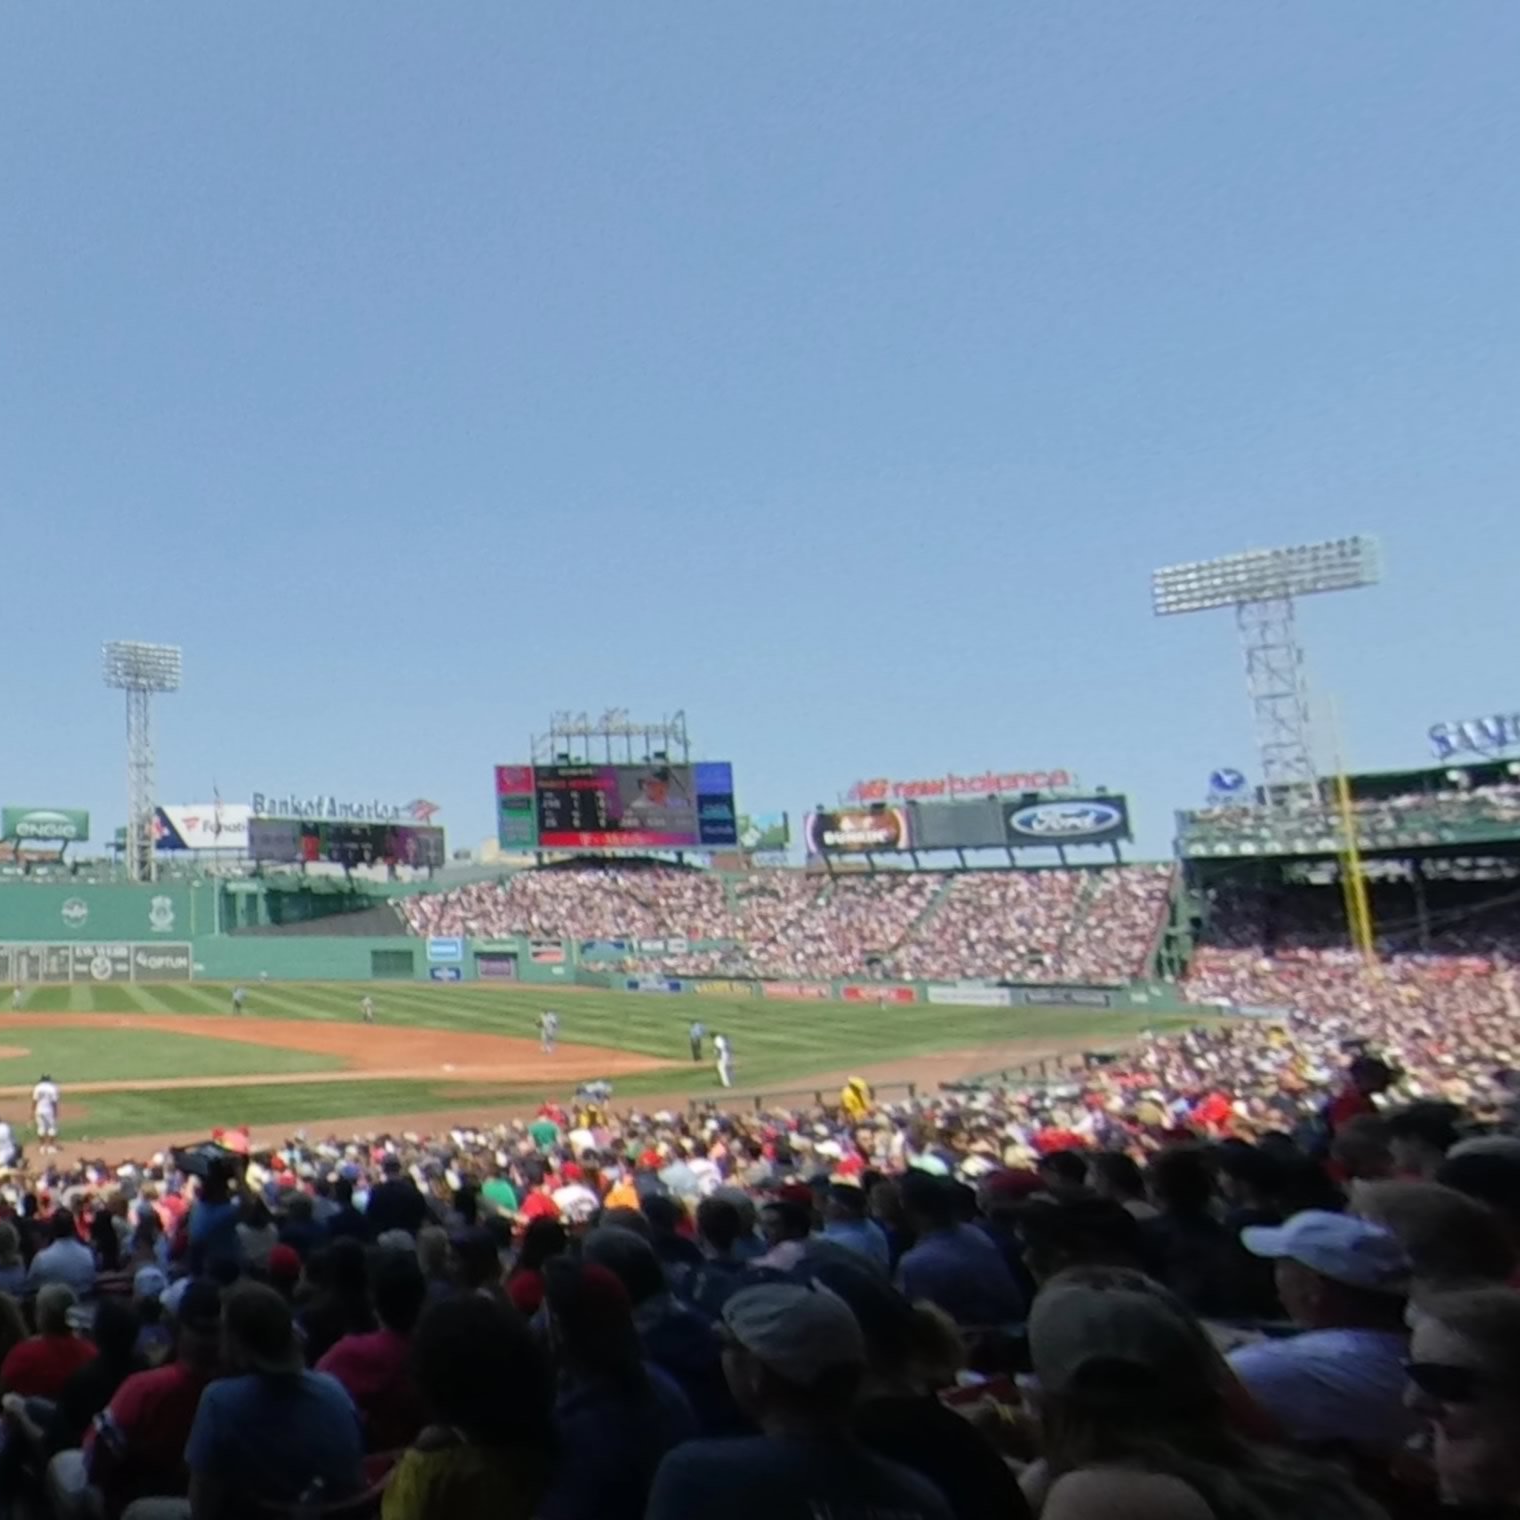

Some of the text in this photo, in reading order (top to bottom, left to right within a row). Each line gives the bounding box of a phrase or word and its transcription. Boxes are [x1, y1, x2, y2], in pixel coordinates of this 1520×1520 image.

[252, 791, 401, 821] Bank of America
[1030, 810, 1097, 833] Ford
[147, 956, 188, 969] OPTUM
